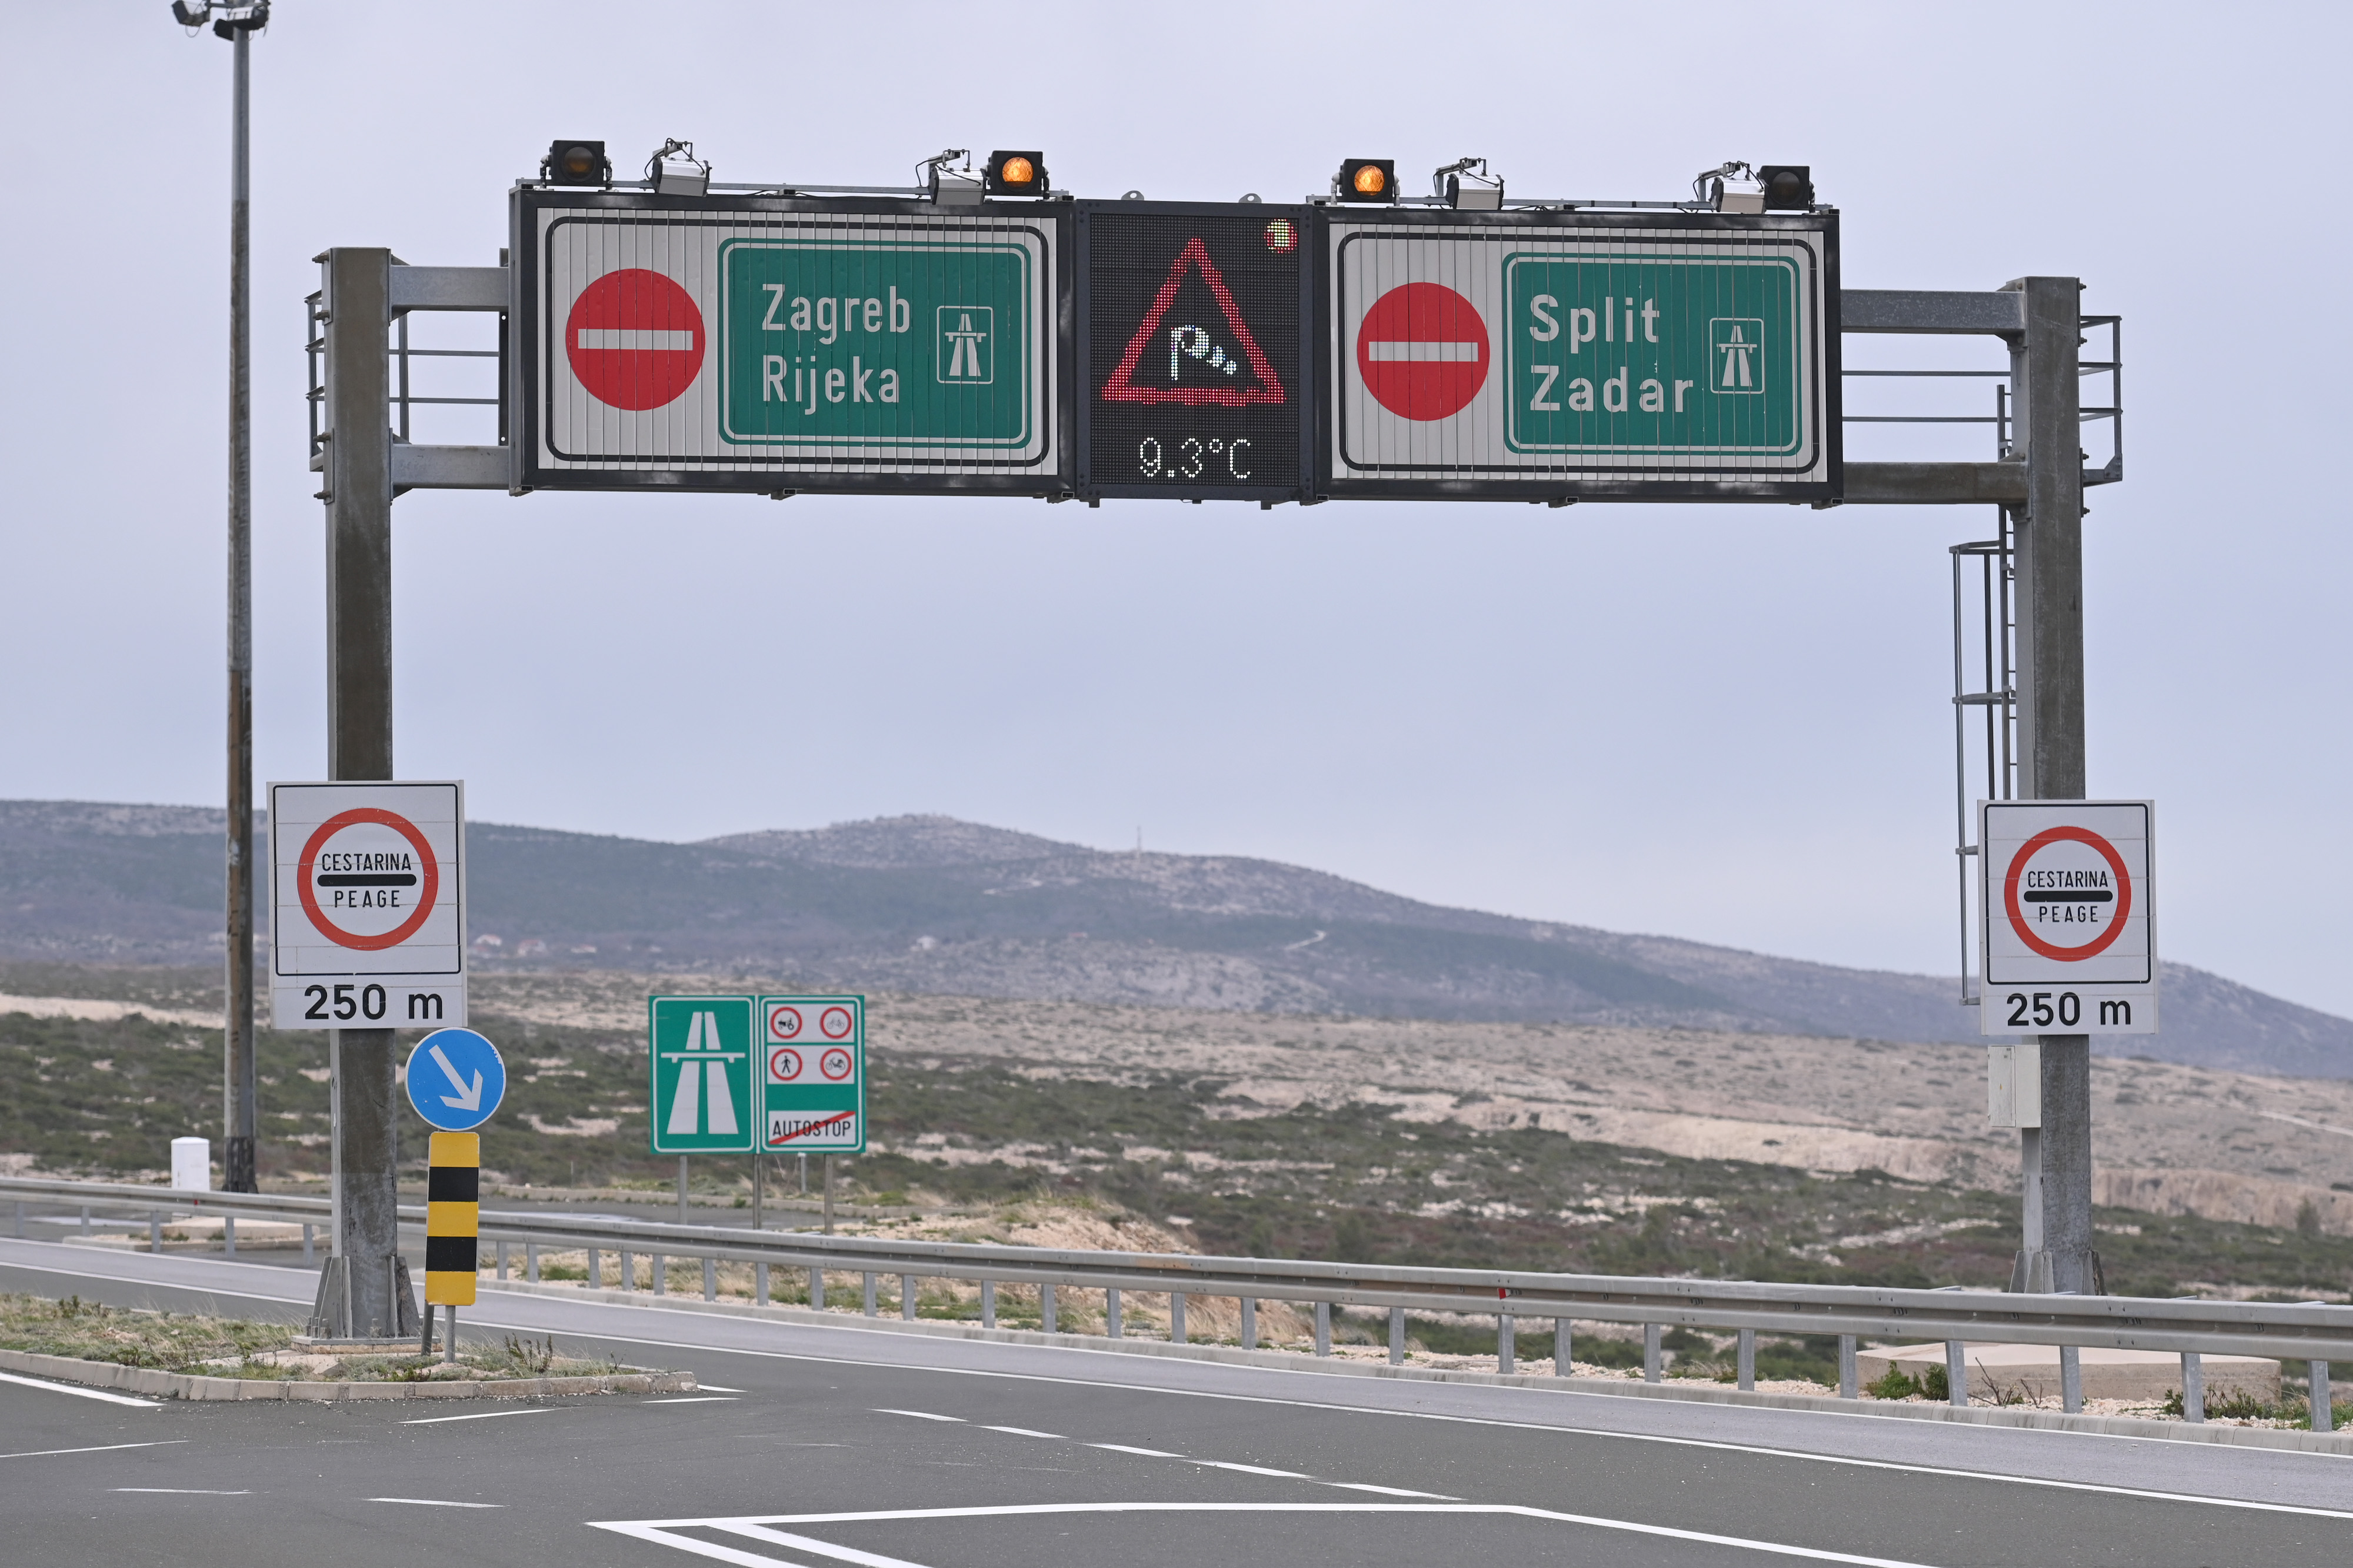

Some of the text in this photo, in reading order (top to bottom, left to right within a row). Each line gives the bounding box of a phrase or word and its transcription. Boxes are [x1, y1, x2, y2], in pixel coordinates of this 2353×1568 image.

[762, 283, 910, 345] Zagreb
[1529, 294, 1660, 354] Split
[762, 355, 899, 415] Rijeka
[1530, 365, 1694, 413] Zadar
[322, 853, 412, 872] CESTARINA
[2028, 870, 2109, 888] CESTARINA
[334, 890, 401, 908] PEAGE
[2039, 906, 2099, 923] PEAGE
[304, 983, 443, 1020] 250 m
[2007, 992, 2132, 1027] 250 m
[772, 1119, 851, 1137] AUTOSTOP
